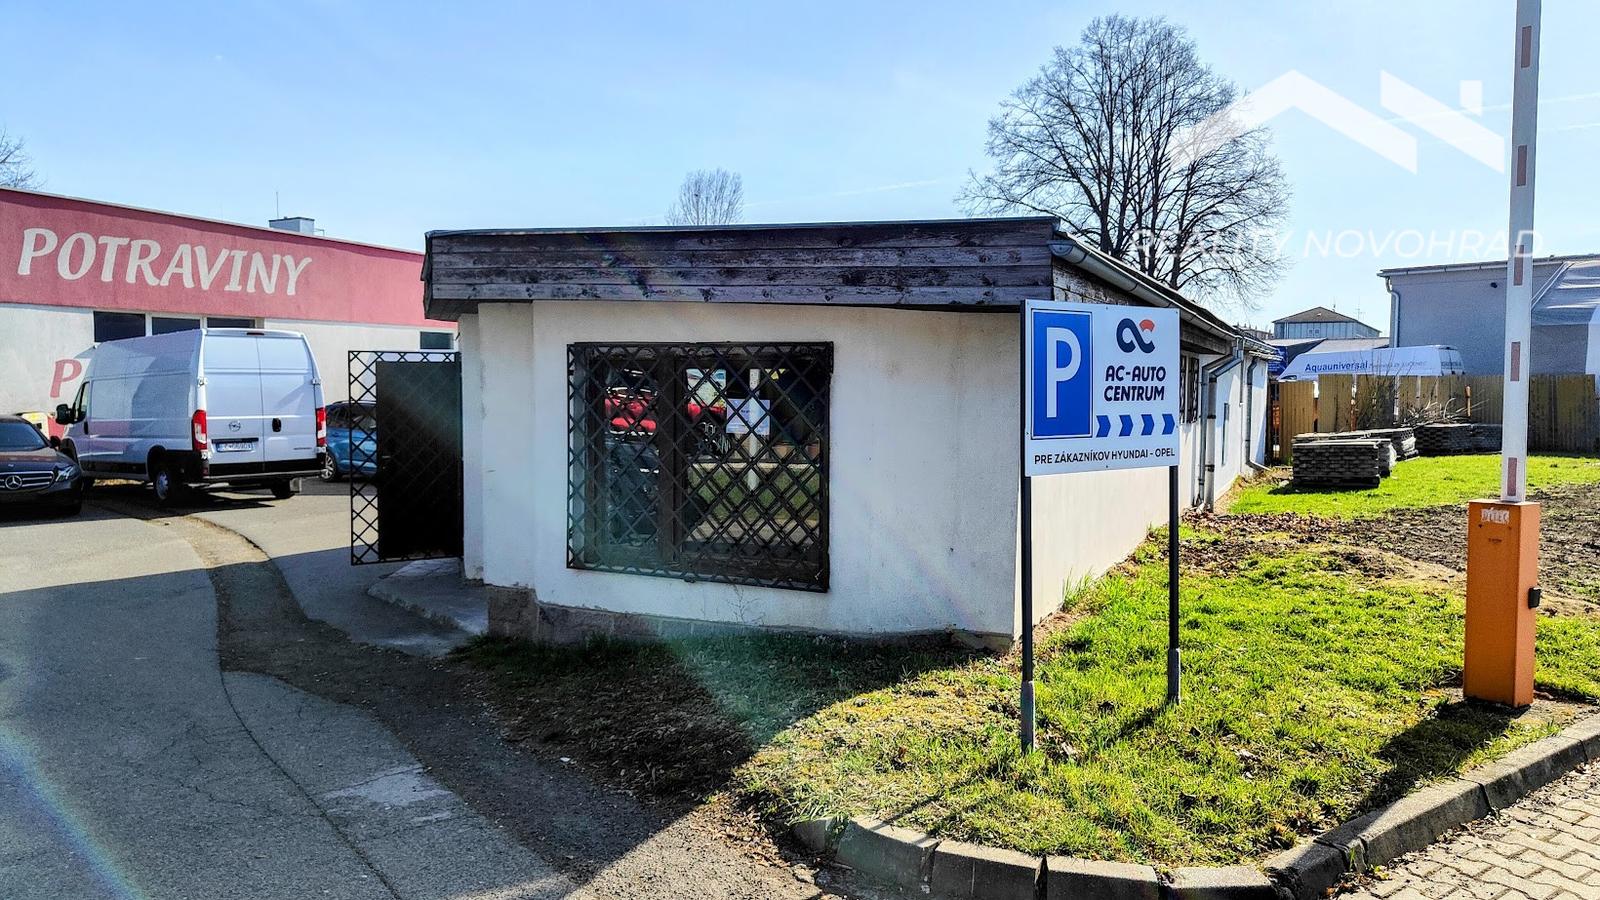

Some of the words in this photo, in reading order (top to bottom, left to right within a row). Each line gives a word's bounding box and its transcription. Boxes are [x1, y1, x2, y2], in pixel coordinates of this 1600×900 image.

[17, 228, 312, 296] POTRAVINY
[1046, 327, 1082, 418] P
[1105, 365, 1166, 382] AC-AUTO
[1104, 385, 1165, 402] CENTRUM
[1034, 454, 1053, 465] PRE
[1054, 450, 1110, 464] ZÁKAZNÍKOV
[1111, 449, 1148, 460] HYUNDAI
[1154, 447, 1176, 458] OPEL
